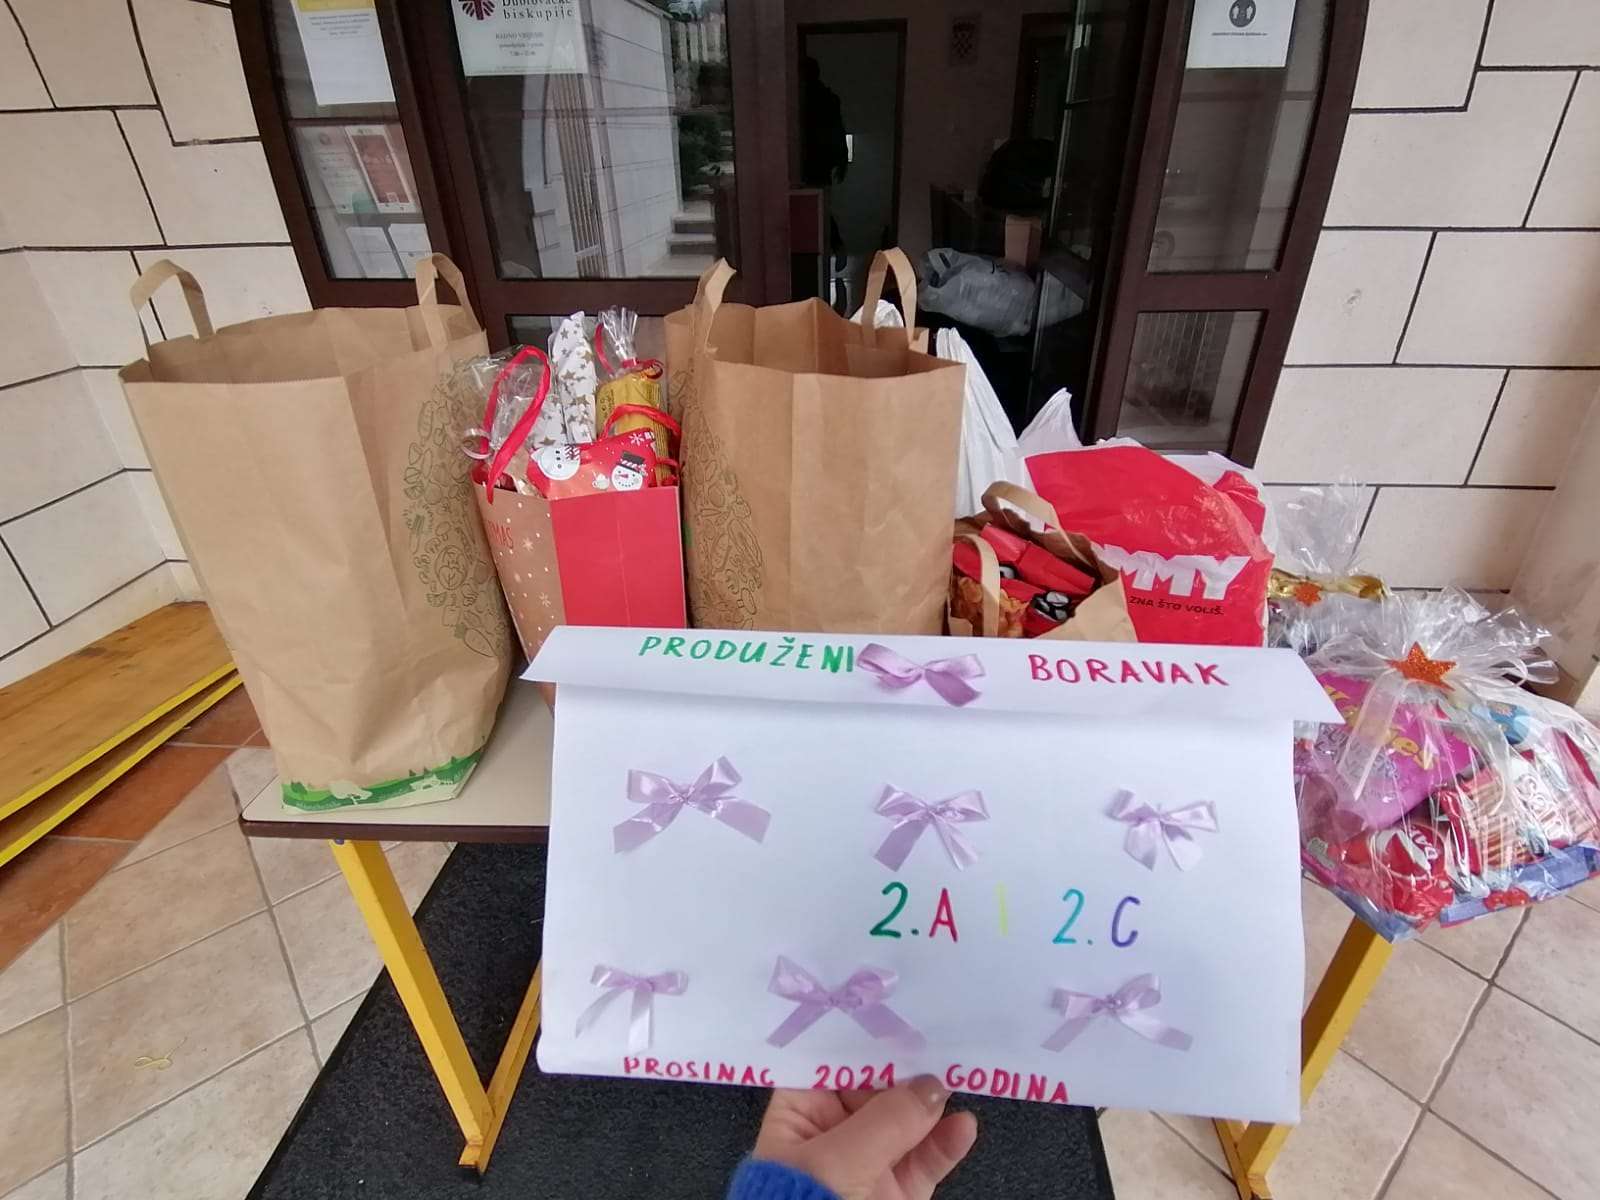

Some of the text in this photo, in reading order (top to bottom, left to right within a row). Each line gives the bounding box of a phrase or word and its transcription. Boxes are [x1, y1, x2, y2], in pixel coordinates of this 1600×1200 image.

[503, 6, 574, 21] biskupije
[1128, 595, 1154, 607] ZNA
[1157, 598, 1182, 610] ŠTO
[639, 635, 1228, 686] PRODUŽENI BORAVAK
[624, 1056, 1069, 1104] PROSINAC 2021 GODINA
